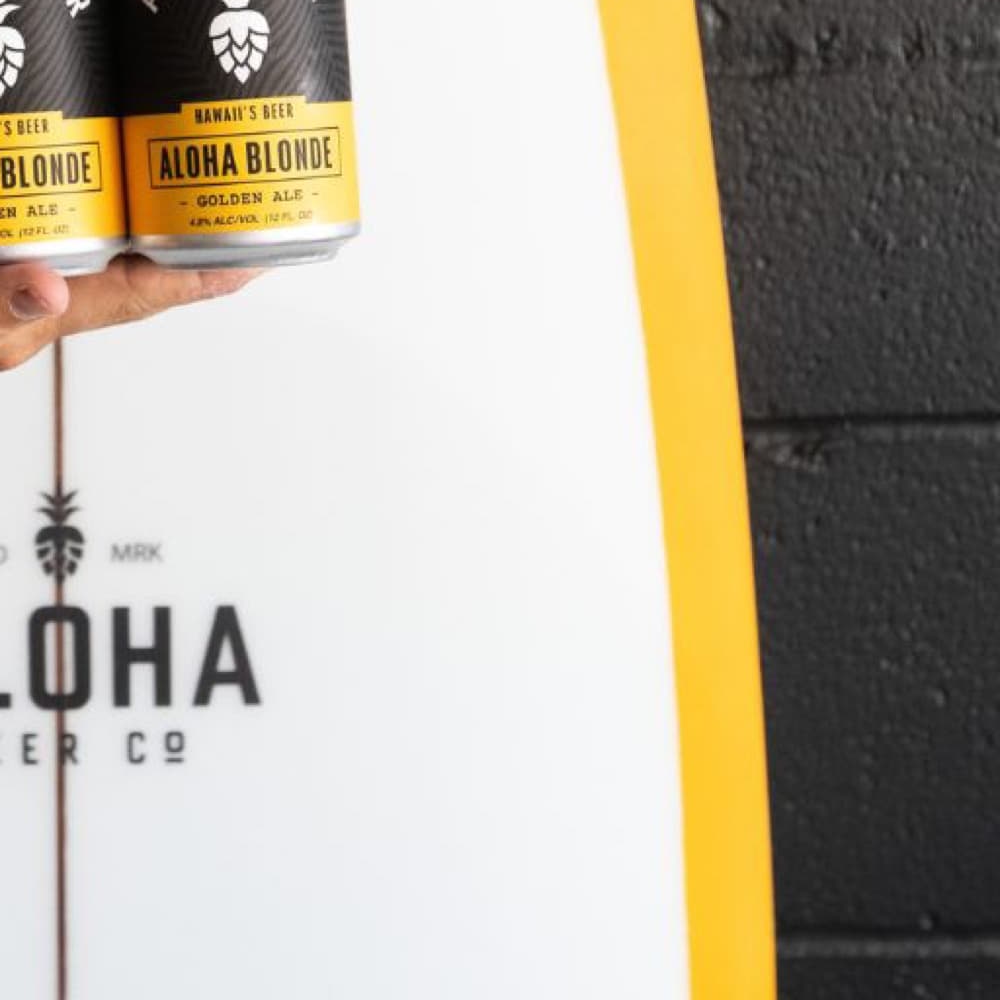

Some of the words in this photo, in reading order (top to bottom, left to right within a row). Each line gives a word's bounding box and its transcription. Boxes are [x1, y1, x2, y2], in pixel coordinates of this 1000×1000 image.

[195, 104, 256, 124] HAWAII'S
[263, 103, 294, 120] BEER
[17, 119, 49, 135] BEER
[160, 143, 238, 180] ALOHA
[245, 136, 332, 175] BLONDE
[1, 152, 92, 188] BLONDE
[197, 192, 263, 207] GOLDEN
[273, 190, 303, 202] ALE
[27, 204, 58, 216] ALE
[110, 542, 164, 563] MRK
